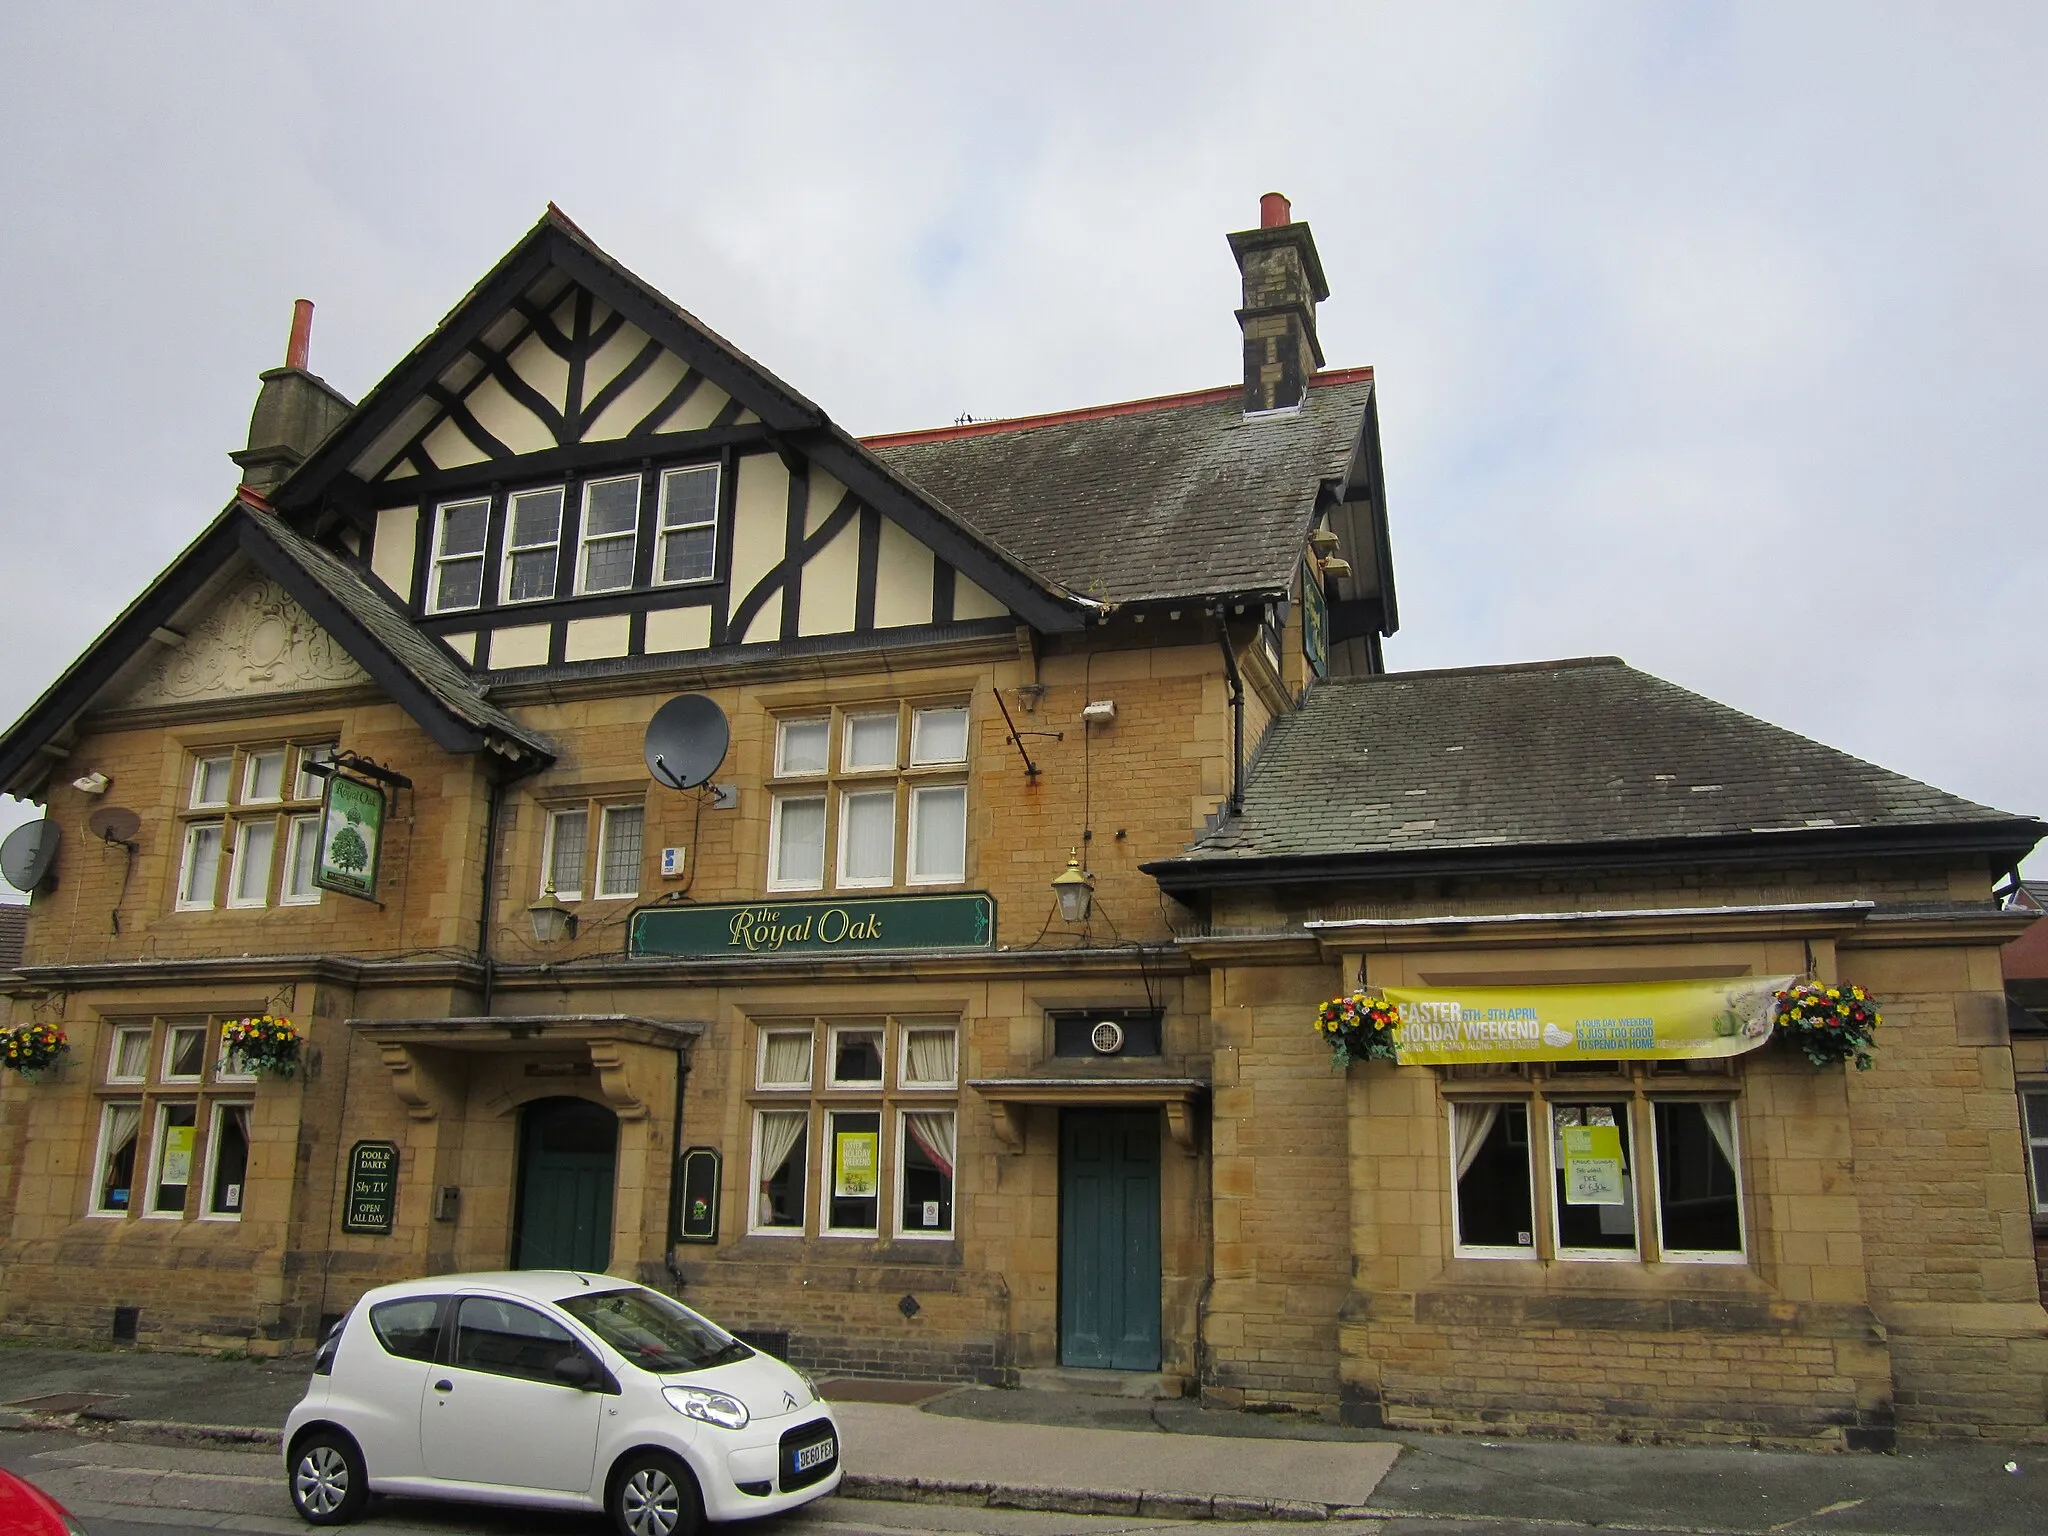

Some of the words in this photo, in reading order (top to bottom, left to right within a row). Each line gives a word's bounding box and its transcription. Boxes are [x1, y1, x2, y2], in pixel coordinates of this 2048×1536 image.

[336, 783, 359, 800] Royal
[757, 908, 780, 922] the
[728, 908, 813, 951] Royal
[818, 909, 882, 944] Oak
[1399, 1002, 1461, 1023] EASTER
[1462, 1009, 1481, 1021] 6TH
[1488, 1008, 1507, 1021] 9TH
[1507, 1008, 1538, 1020] APRIL
[1583, 1019, 1600, 1027] FOUR
[1603, 1019, 1616, 1027] DAY
[1619, 1018, 1653, 1026] WEEKEND
[1401, 1022, 1461, 1042] HOLIDAY
[1463, 1021, 1540, 1041] WEEKEND
[1576, 1029, 1584, 1038] IS
[1587, 1028, 1608, 1038] JUST
[1611, 1028, 1627, 1038] TOO
[1630, 1028, 1653, 1038] GOOD
[1468, 1041, 1492, 1050] ALONG
[1495, 1041, 1510, 1049] THIS
[1513, 1040, 1540, 1049] EASTER
[1577, 1040, 1588, 1050] TO
[1588, 1040, 1617, 1050] SPEND
[1618, 1040, 1629, 1049] AT
[1630, 1039, 1654, 1049] HOME
[361, 1151, 383, 1160] POOL
[384, 1152, 390, 1160] &
[361, 1161, 386, 1169] DARTS
[355, 1182, 371, 1194] Sky
[360, 1204, 380, 1212] OPEN
[353, 1214, 367, 1222] ALL
[368, 1214, 384, 1223] DAY
